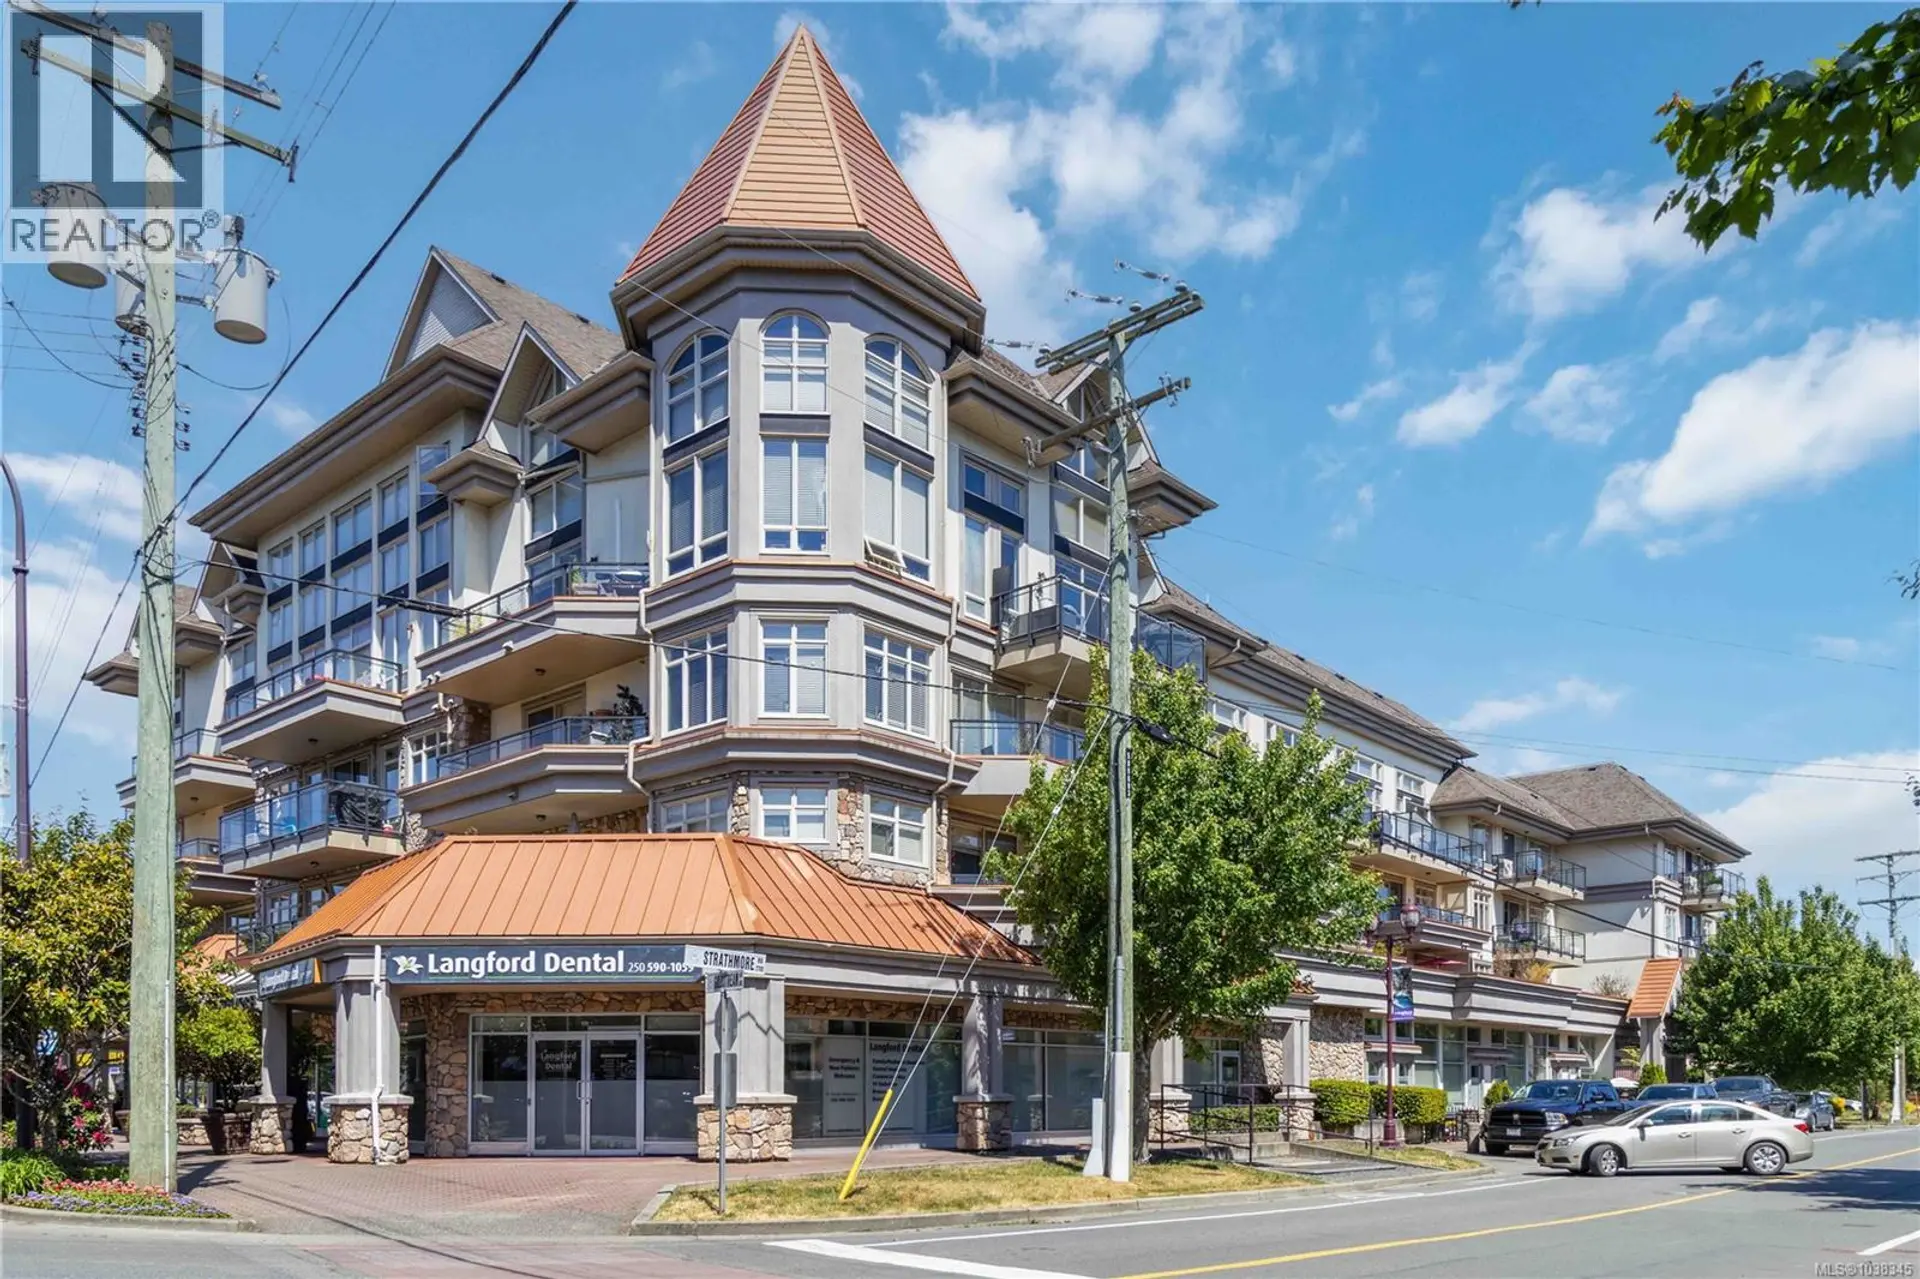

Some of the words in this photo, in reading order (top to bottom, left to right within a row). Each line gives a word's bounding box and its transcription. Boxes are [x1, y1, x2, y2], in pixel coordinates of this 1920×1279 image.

[428, 950, 536, 979] Langford
[544, 950, 625, 973] Dental
[628, 962, 646, 973] 250
[703, 951, 756, 971] STRATHMORE
